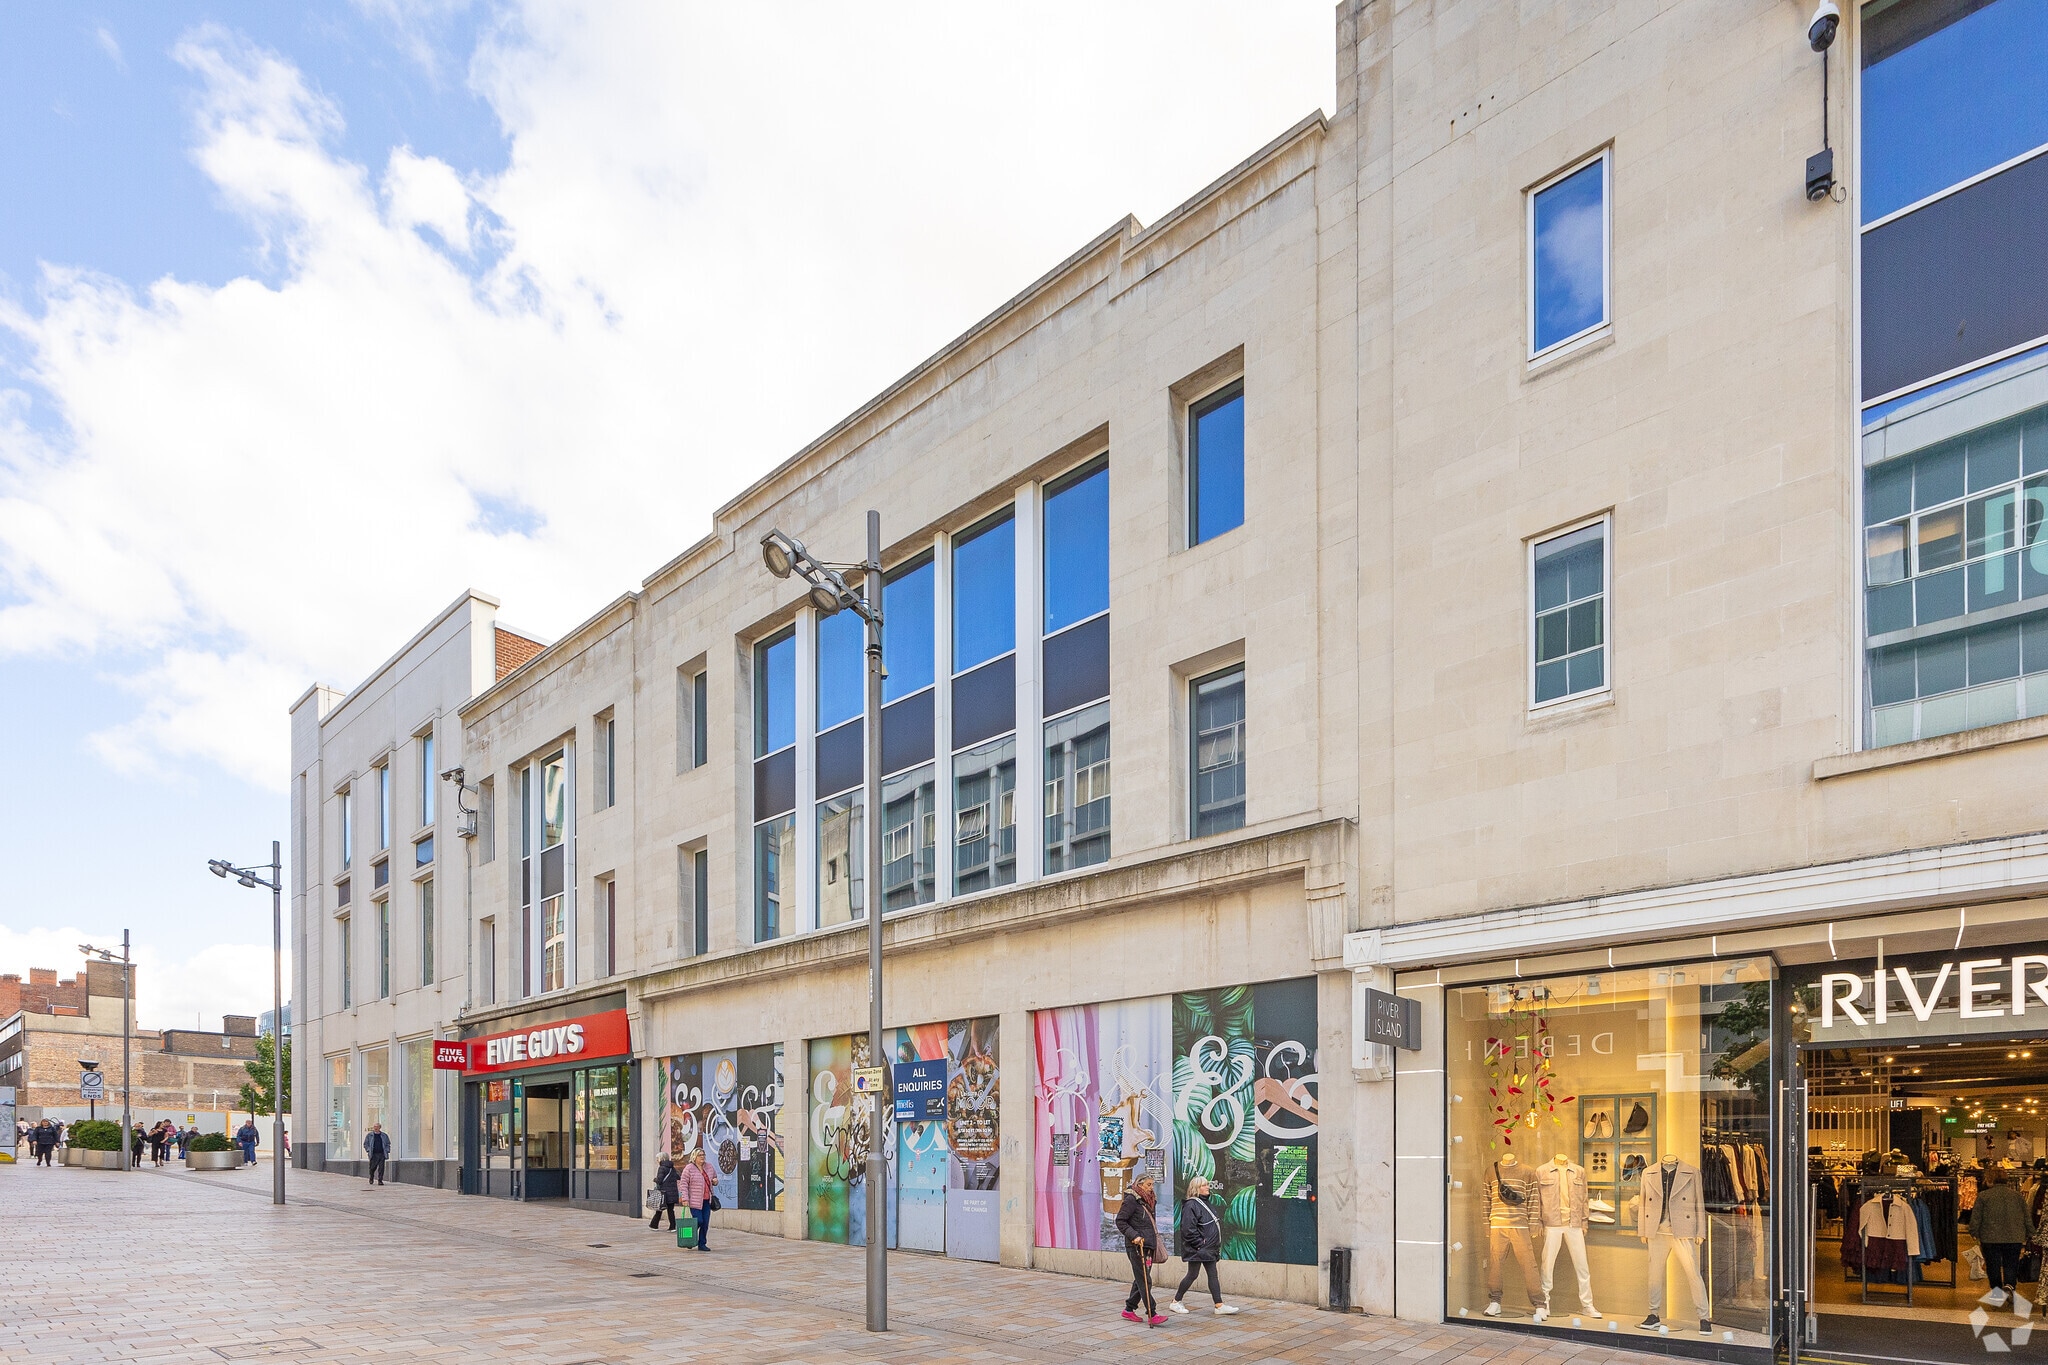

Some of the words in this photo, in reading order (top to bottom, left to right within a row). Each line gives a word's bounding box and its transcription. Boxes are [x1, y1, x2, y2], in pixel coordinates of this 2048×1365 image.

[1821, 954, 2048, 1028] RIVER
[1377, 999, 1400, 1018] RIVER
[1374, 1018, 1402, 1039] ISLAND
[487, 1034, 527, 1066] FIVE
[528, 1023, 584, 1059] GUYS
[439, 1047, 463, 1056] FIVE
[436, 1055, 466, 1063] GUYS
[912, 1067, 927, 1078] ALL
[897, 1080, 943, 1093] ENQUIRIES
[1890, 1100, 1904, 1108] LIFT
